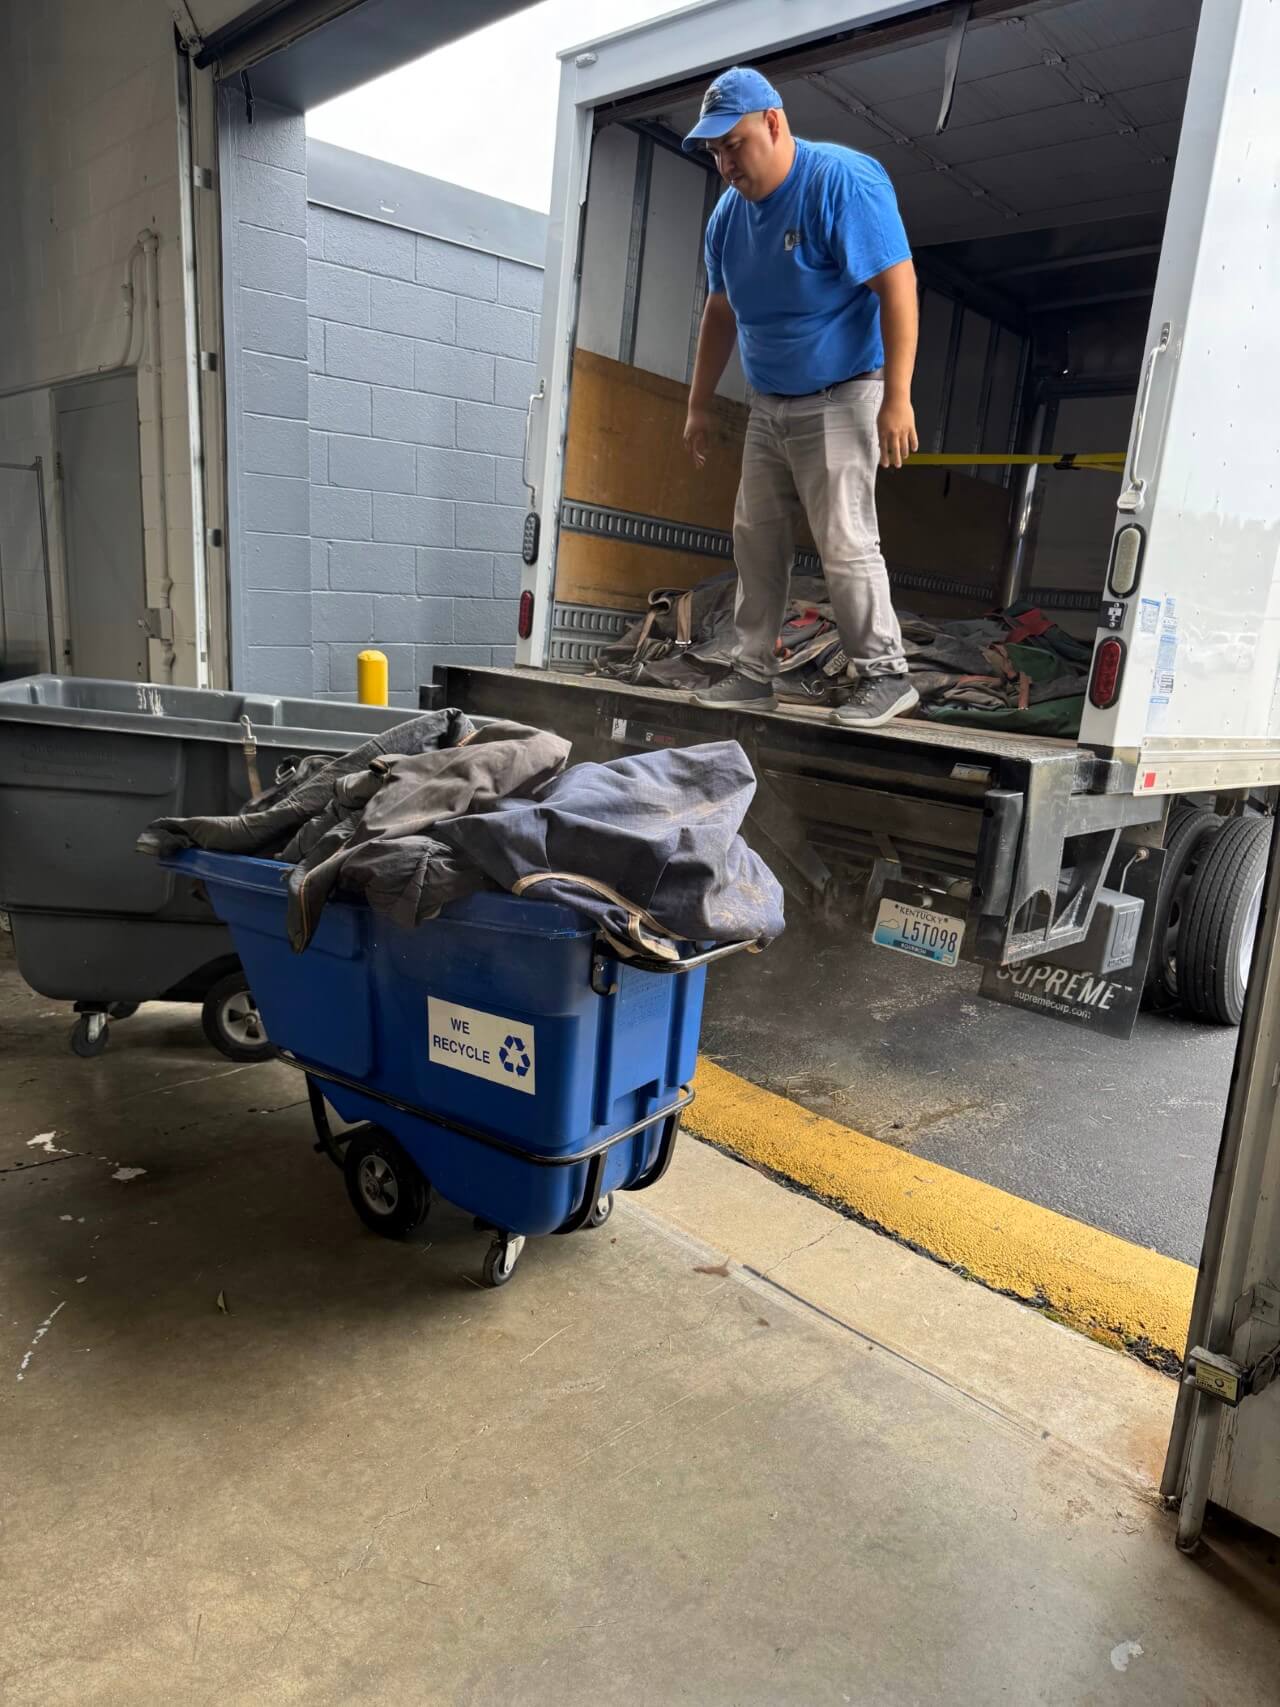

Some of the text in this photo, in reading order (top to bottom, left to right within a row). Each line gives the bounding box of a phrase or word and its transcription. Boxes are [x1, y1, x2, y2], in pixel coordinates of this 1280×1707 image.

[899, 906, 944, 924] KENTUCKY
[901, 918, 958, 953] L5T098
[1013, 990, 1092, 1020] supremecorp.com
[450, 1017, 470, 1035] WE
[433, 1034, 491, 1064] RECYCLE
